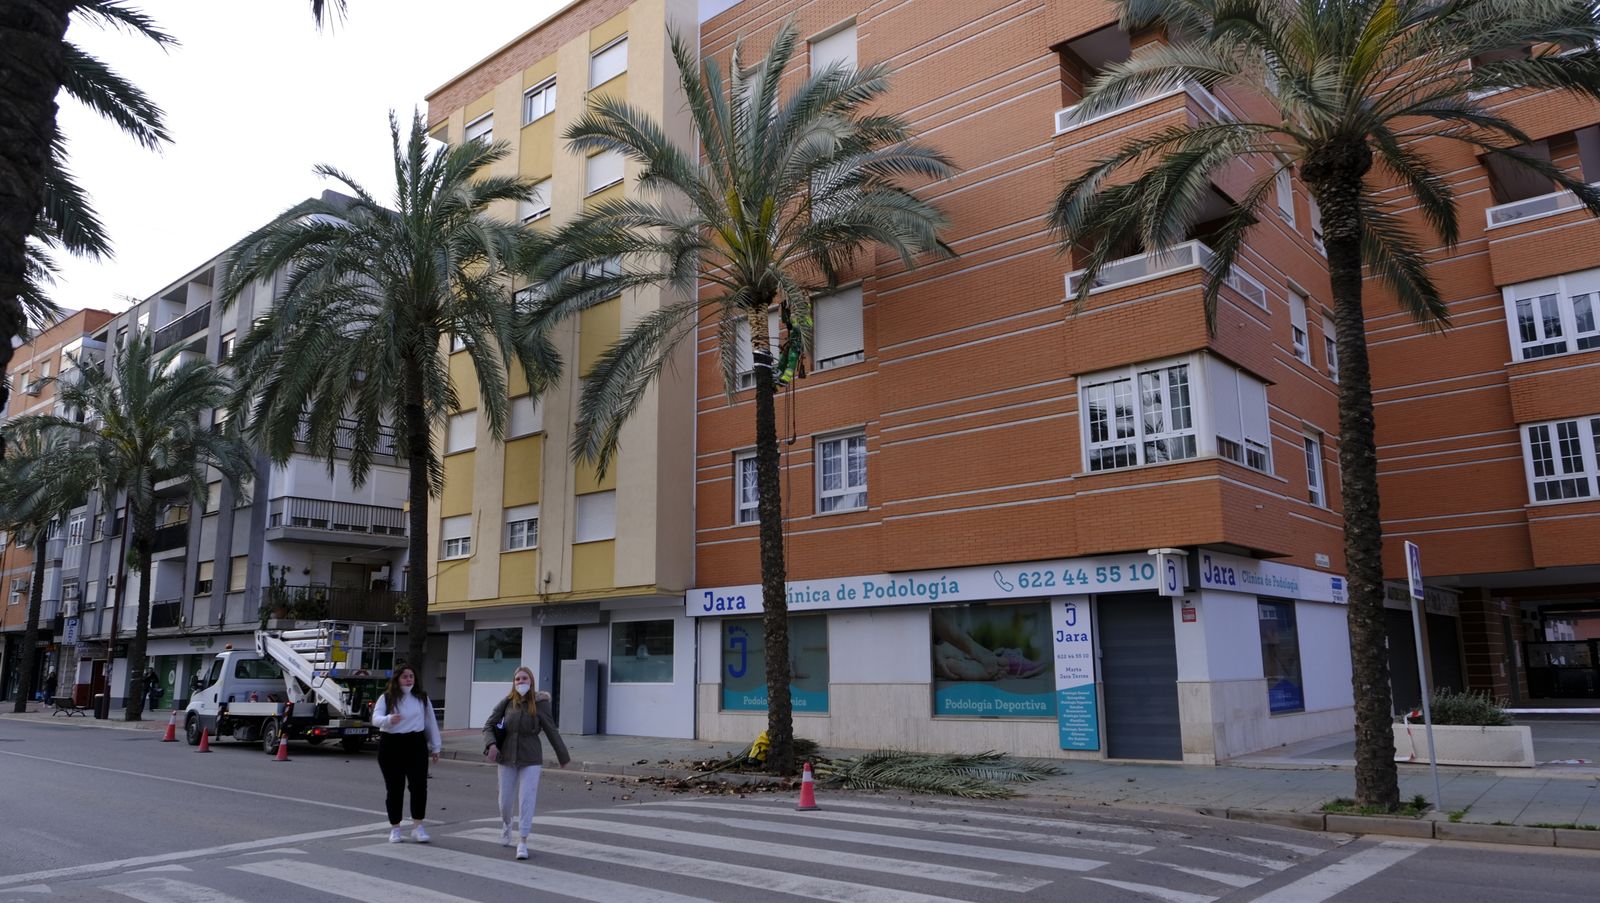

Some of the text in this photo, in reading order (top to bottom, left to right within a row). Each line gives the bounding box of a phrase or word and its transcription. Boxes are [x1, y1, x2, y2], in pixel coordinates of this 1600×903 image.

[1018, 563, 1155, 589] 622 44 55 10
[1204, 555, 1236, 586] Jara
[788, 575, 960, 604] ínica de Podología
[1265, 574, 1272, 587] de
[703, 591, 746, 612] Jara
[1056, 630, 1088, 643] Jara
[743, 696, 768, 706] Podolo
[994, 698, 1047, 713] Deportiva
